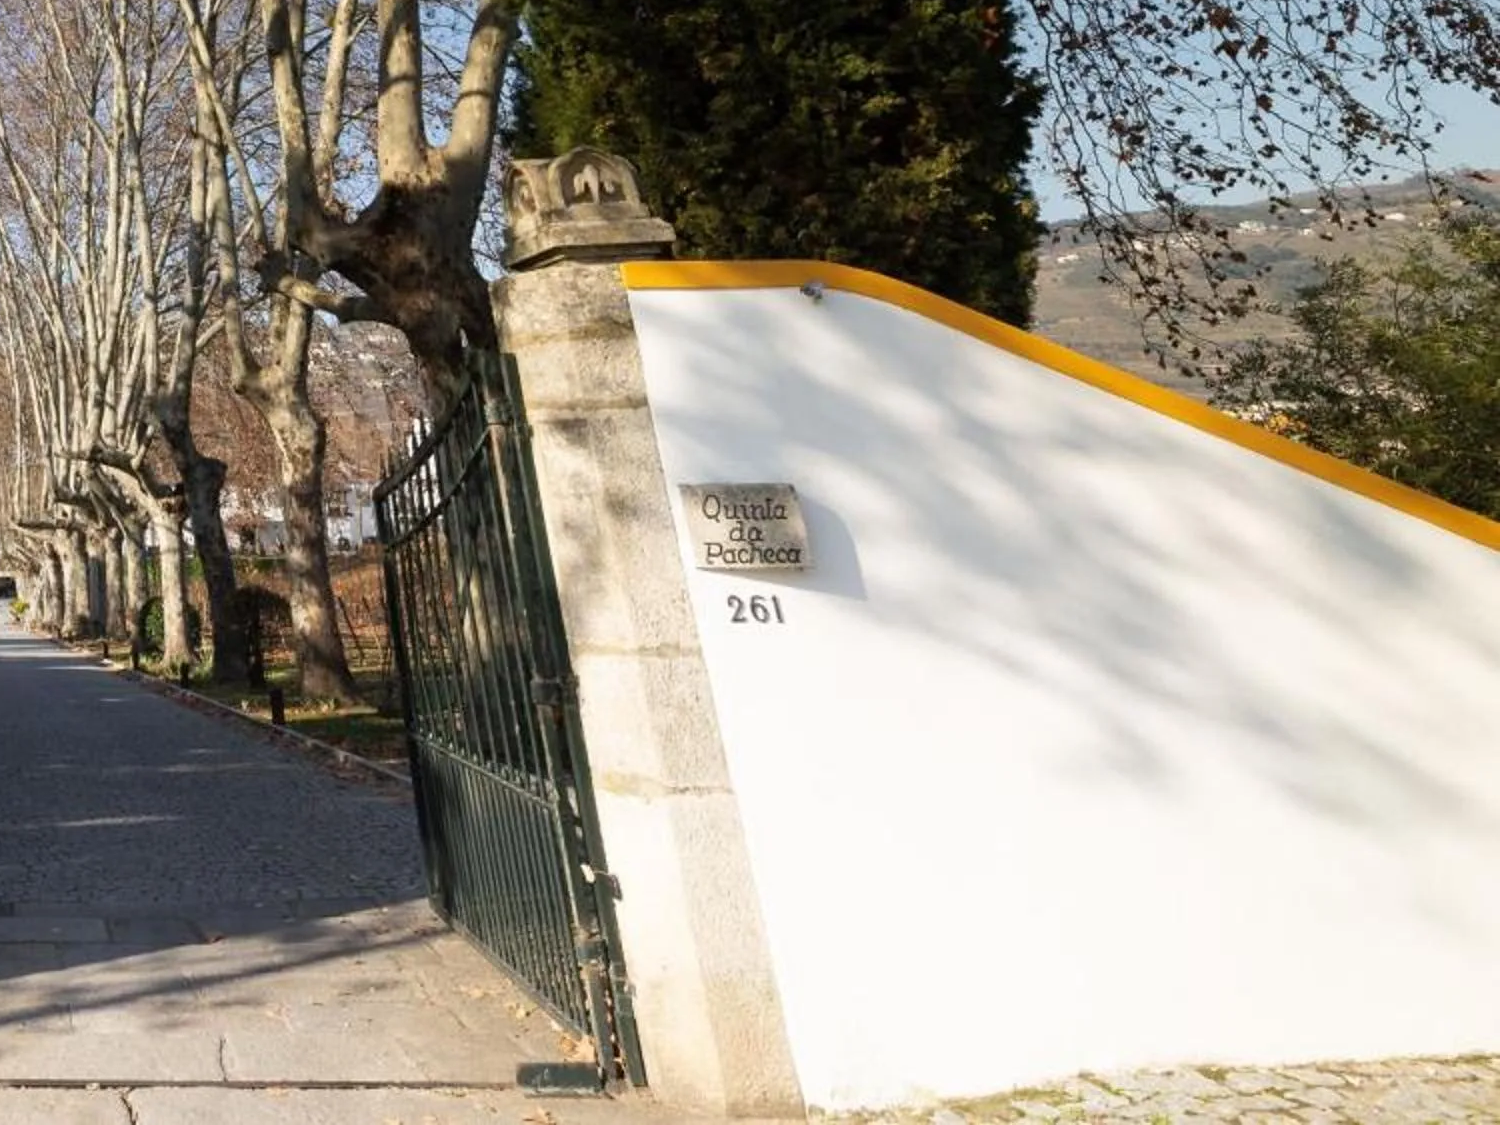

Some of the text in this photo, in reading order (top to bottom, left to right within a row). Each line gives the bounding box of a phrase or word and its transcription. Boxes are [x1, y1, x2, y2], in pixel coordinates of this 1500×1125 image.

[702, 494, 788, 523] Quinta
[729, 520, 764, 542] da
[704, 541, 802, 565] Pacheca
[727, 594, 786, 623] 261
